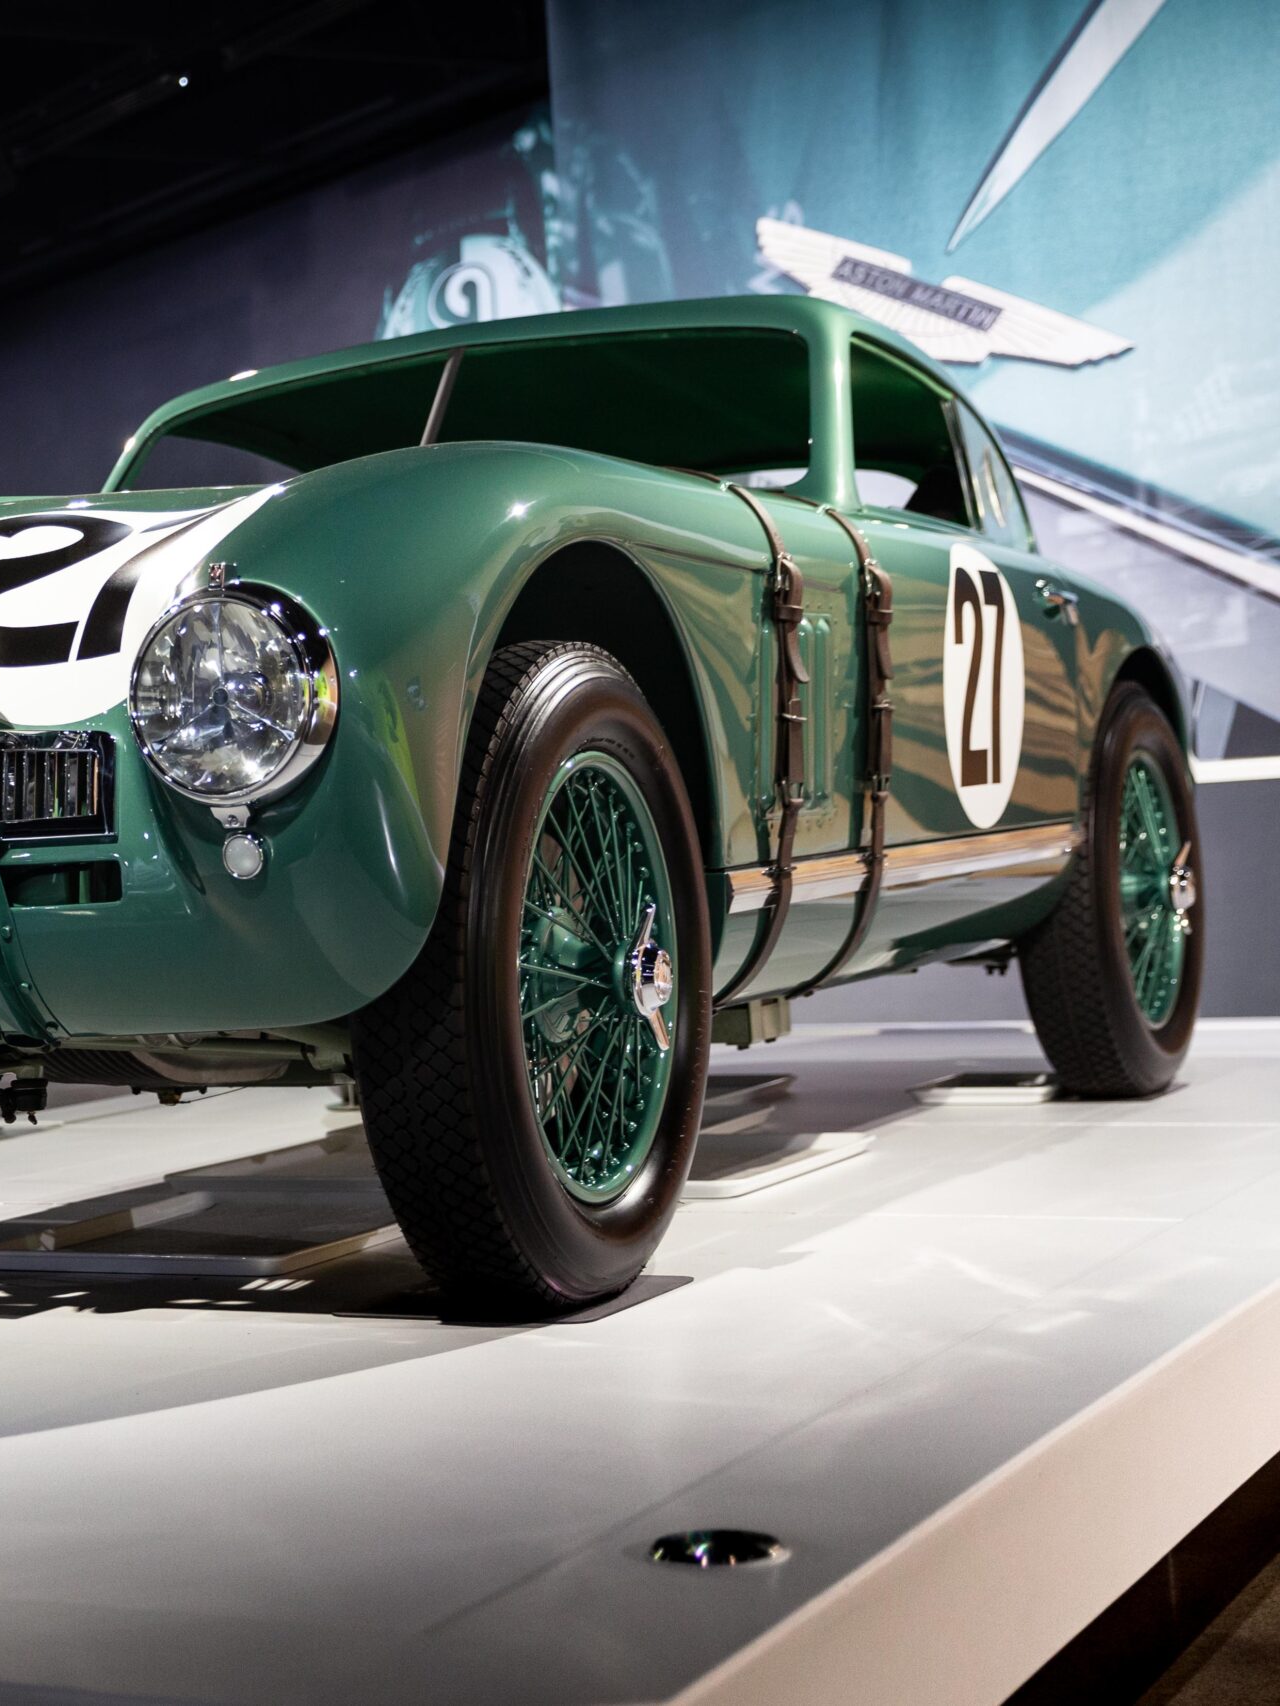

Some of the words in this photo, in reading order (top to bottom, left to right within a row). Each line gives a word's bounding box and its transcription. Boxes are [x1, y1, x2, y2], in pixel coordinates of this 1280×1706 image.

[837, 259, 912, 299] ASTON
[910, 285, 997, 330] MARTIN
[954, 567, 1005, 787] 27
